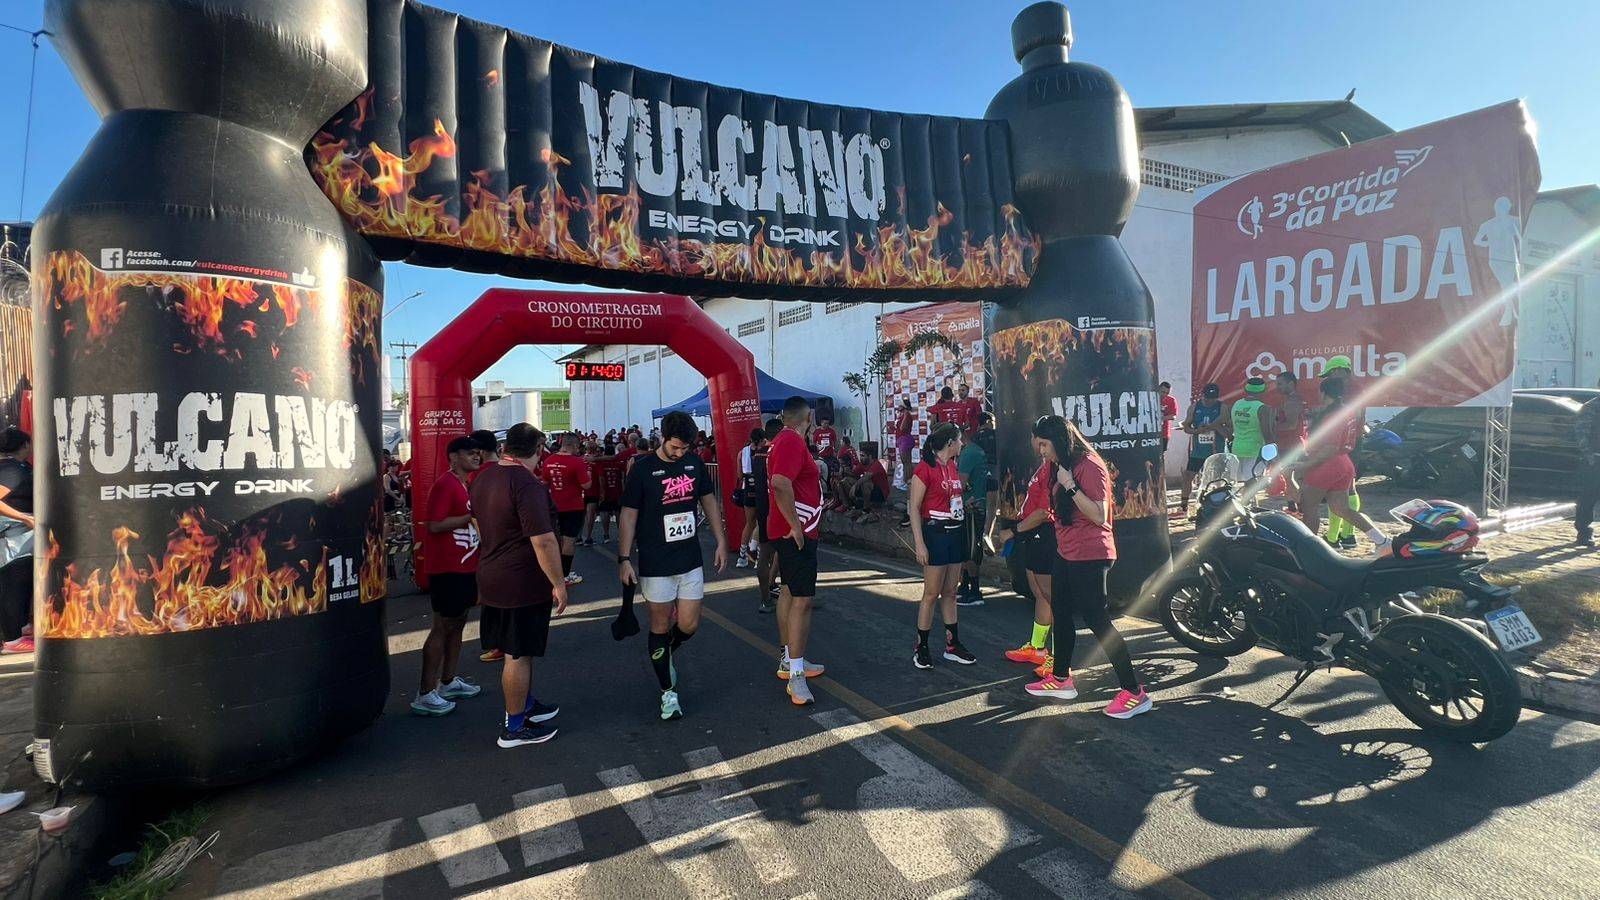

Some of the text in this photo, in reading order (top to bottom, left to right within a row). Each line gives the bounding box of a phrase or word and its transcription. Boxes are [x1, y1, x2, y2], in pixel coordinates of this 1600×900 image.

[579, 81, 886, 221] VULCANO
[1297, 166, 1399, 206] Corrida
[1286, 189, 1398, 232] da Paz
[648, 209, 840, 247] ENERGY DRINK
[126, 250, 162, 259] Acesse:
[1206, 226, 1473, 324] LARGADA
[528, 301, 662, 316] CRONOMETRAGEM
[552, 316, 643, 329] DO CIRCUITO
[1293, 345, 1352, 356] FACULDADE
[1293, 344, 1407, 380] mlta
[567, 363, 623, 378] 01:14:00
[424, 410, 451, 418] GRUPO
[53, 391, 357, 477] VULCANO
[100, 479, 314, 501] ENERGY DRINK
[668, 523, 694, 537] 2414
[328, 554, 359, 589] 1L
